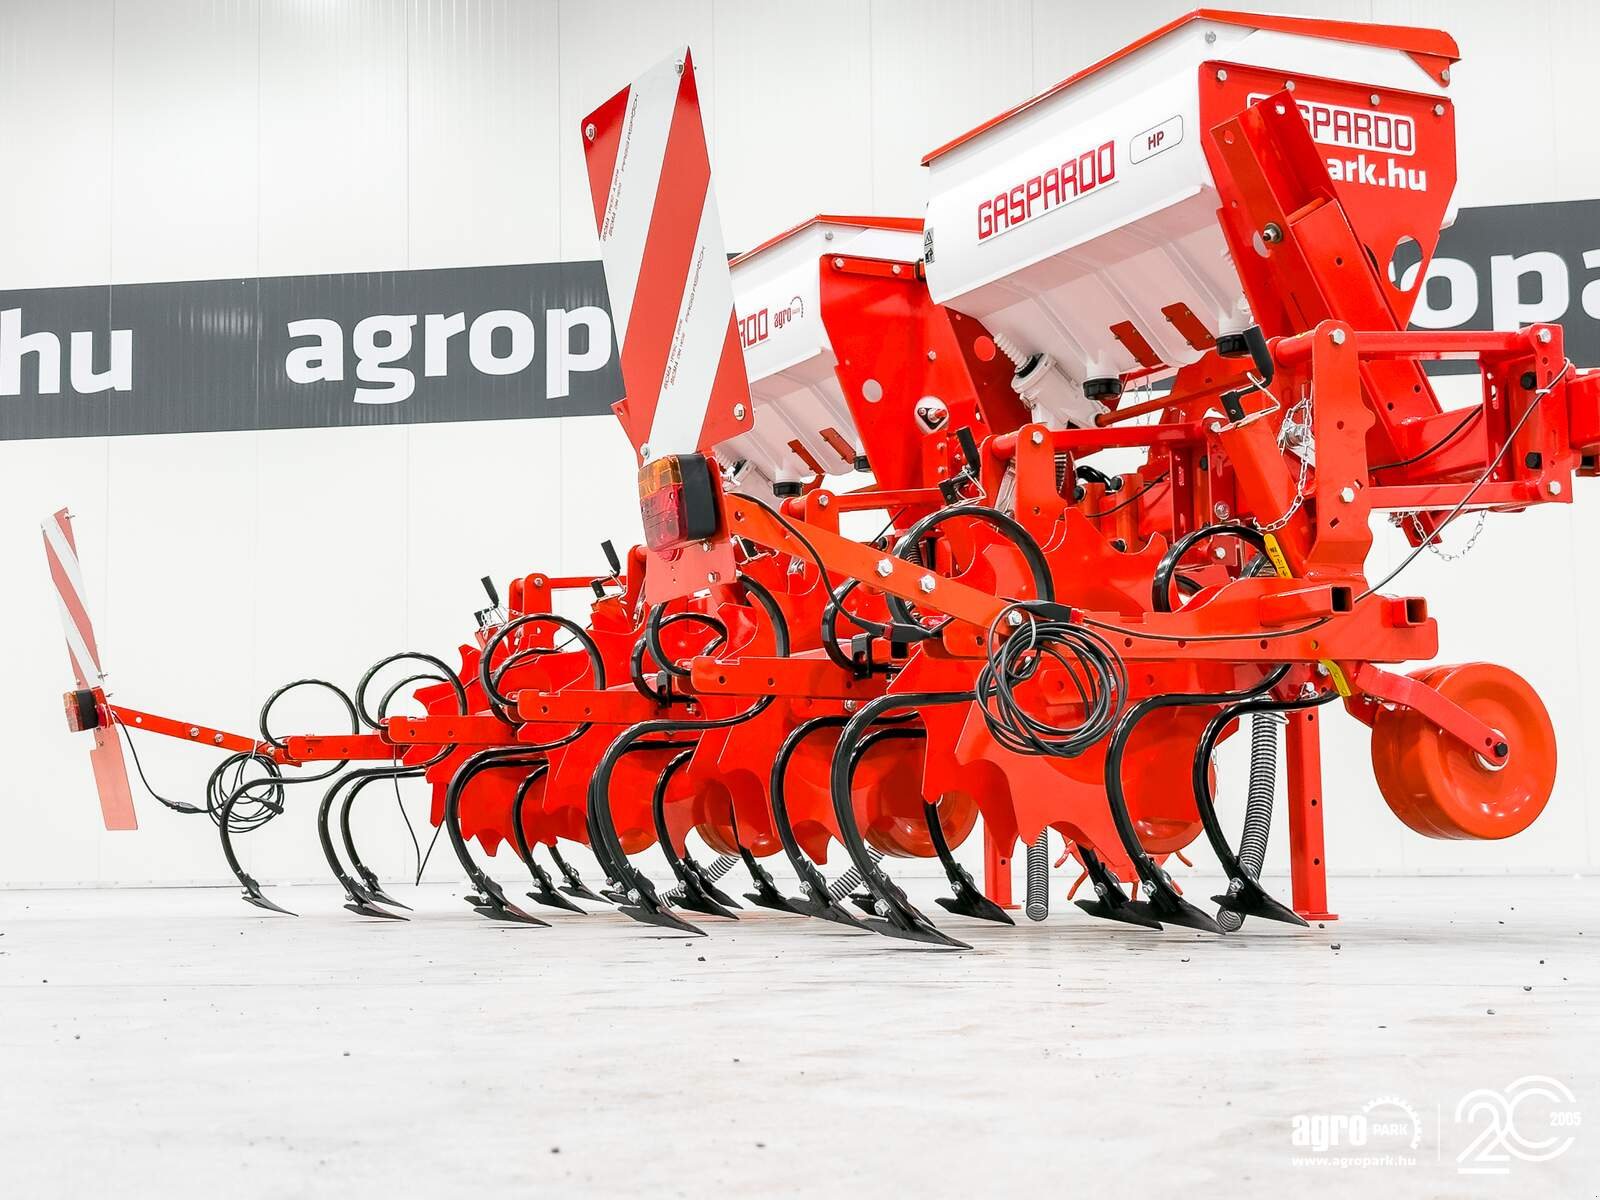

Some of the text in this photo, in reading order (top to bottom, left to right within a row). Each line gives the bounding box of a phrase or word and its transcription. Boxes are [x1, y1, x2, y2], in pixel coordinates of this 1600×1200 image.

[1148, 131, 1164, 150] HP
[1250, 98, 1411, 151] PARDO
[978, 140, 1115, 240] GASPARDO
[285, 304, 612, 404] agrop
